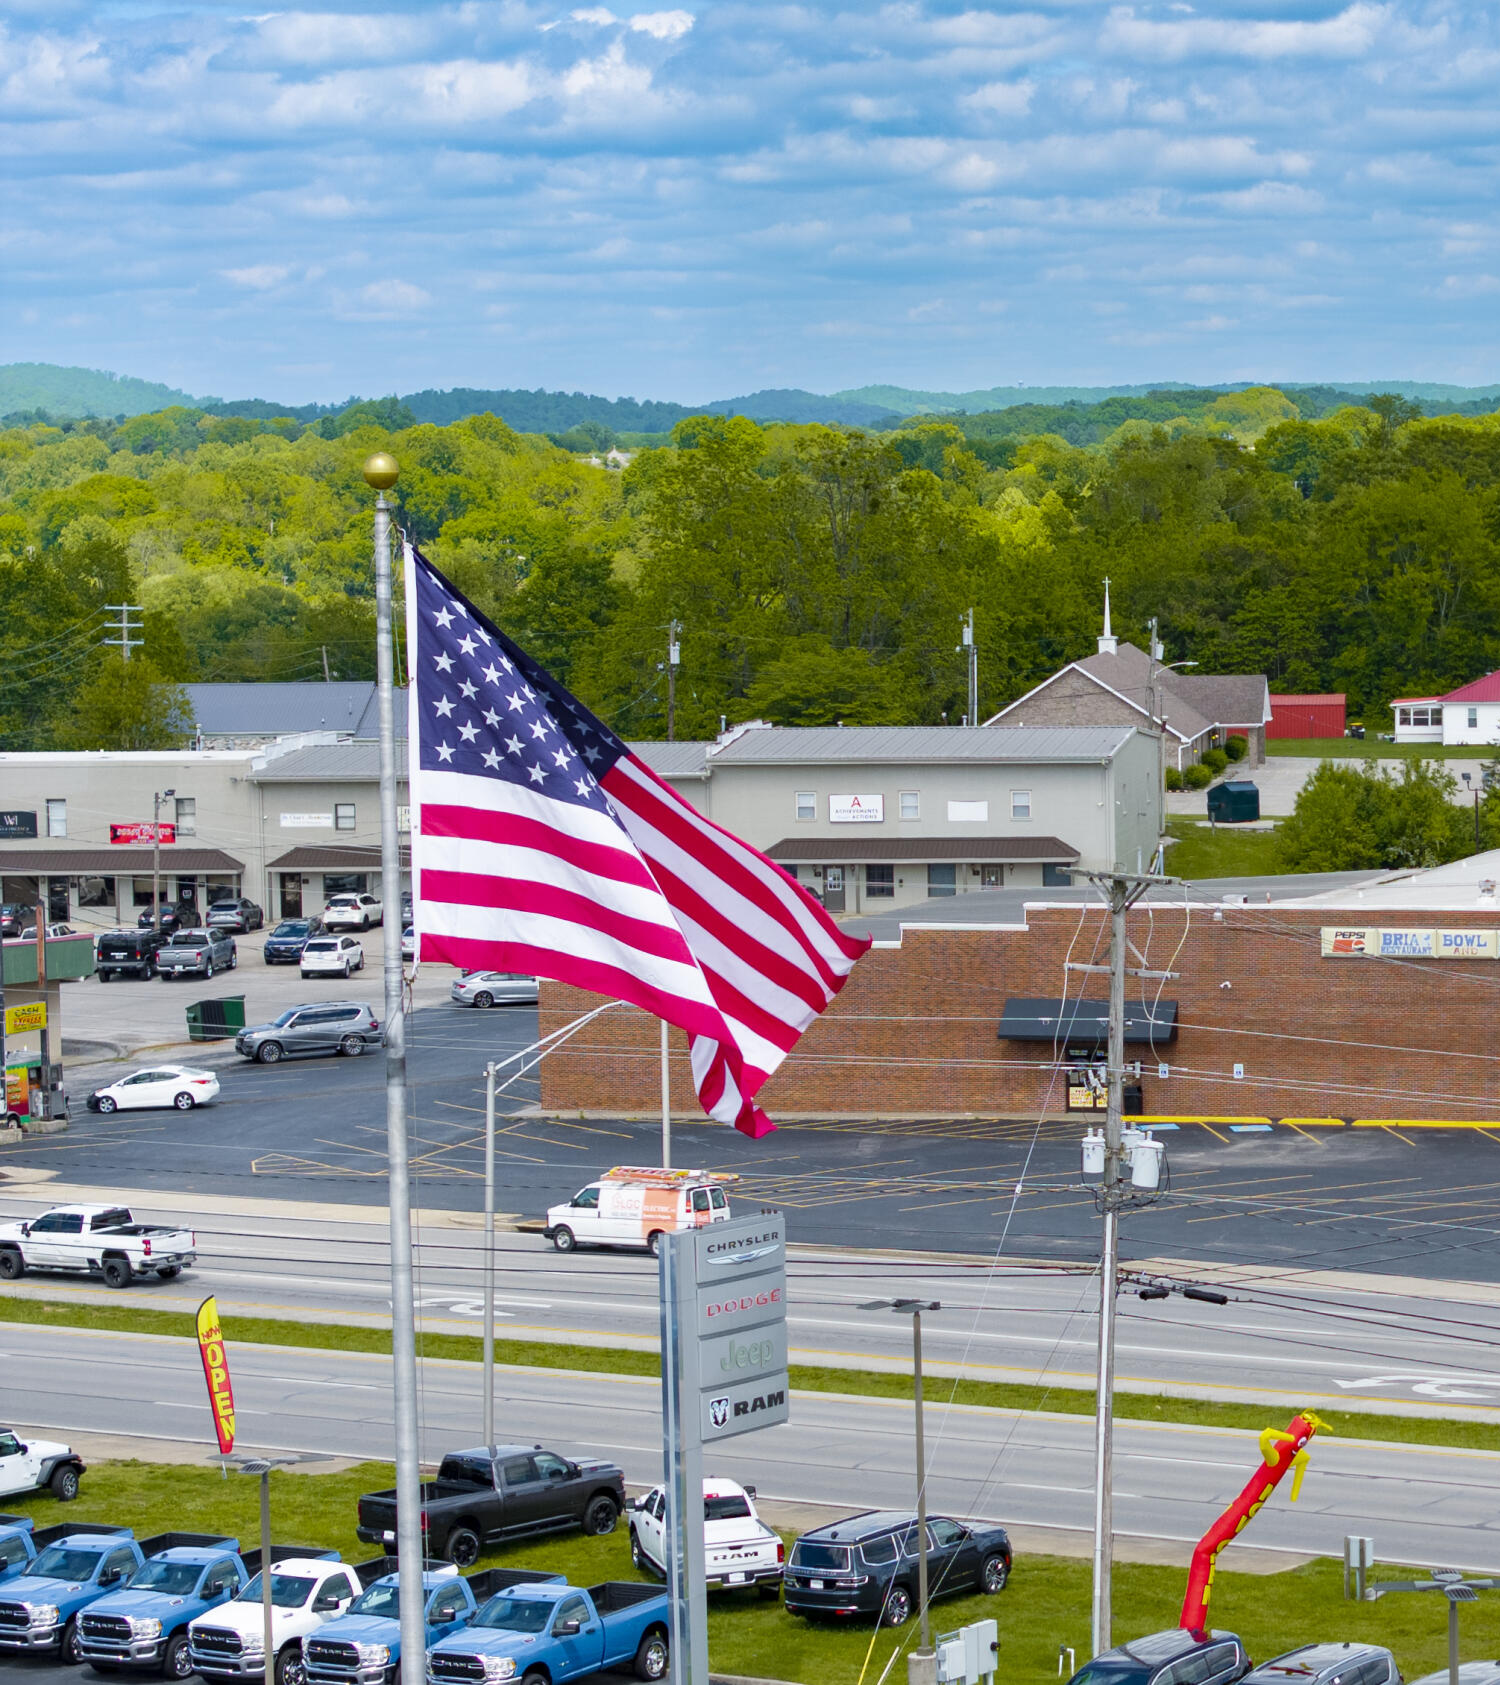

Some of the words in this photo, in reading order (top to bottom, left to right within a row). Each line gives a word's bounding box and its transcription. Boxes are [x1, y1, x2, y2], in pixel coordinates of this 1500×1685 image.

[1335, 931, 1366, 939] PEPSI
[1443, 934, 1487, 947] BOWL
[1381, 946, 1432, 954] RESTAURANT
[1453, 947, 1478, 955] AND
[14, 1007, 39, 1018] CASH
[706, 1231, 780, 1254] CHRYSLER
[706, 1288, 782, 1318] DODGE
[201, 1325, 221, 1342] NOW
[720, 1339, 774, 1373] Jeep
[206, 1343, 236, 1441] OPEN
[733, 1390, 785, 1417] RAM
[713, 1551, 759, 1561] RAM
